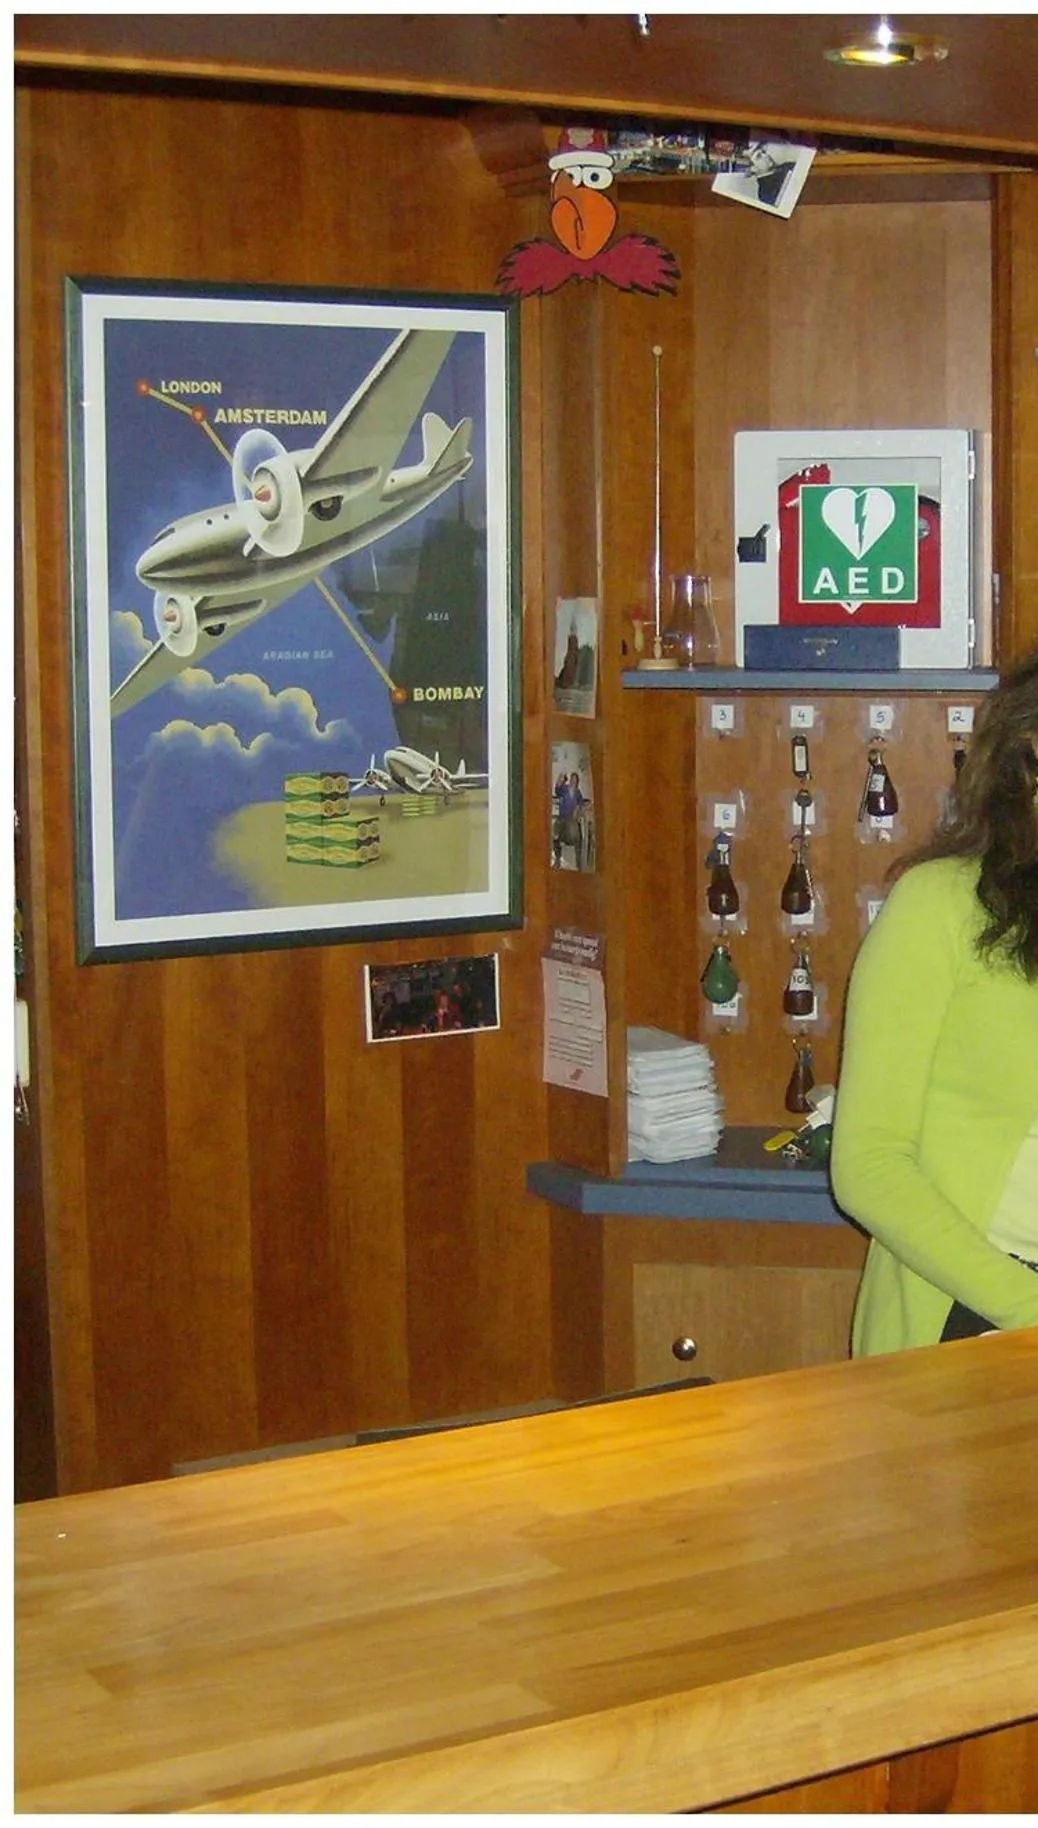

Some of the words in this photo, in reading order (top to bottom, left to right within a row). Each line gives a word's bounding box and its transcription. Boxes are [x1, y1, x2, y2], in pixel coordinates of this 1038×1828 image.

[161, 380, 222, 394] LONDON
[215, 408, 327, 425] AMSTERDAM
[812, 566, 905, 594] AED
[413, 686, 484, 701] BOMBAY
[719, 709, 727, 721] 3
[797, 710, 805, 722] 4
[875, 711, 886, 723] 5
[952, 711, 965, 723] 2
[722, 809, 730, 821] 6
